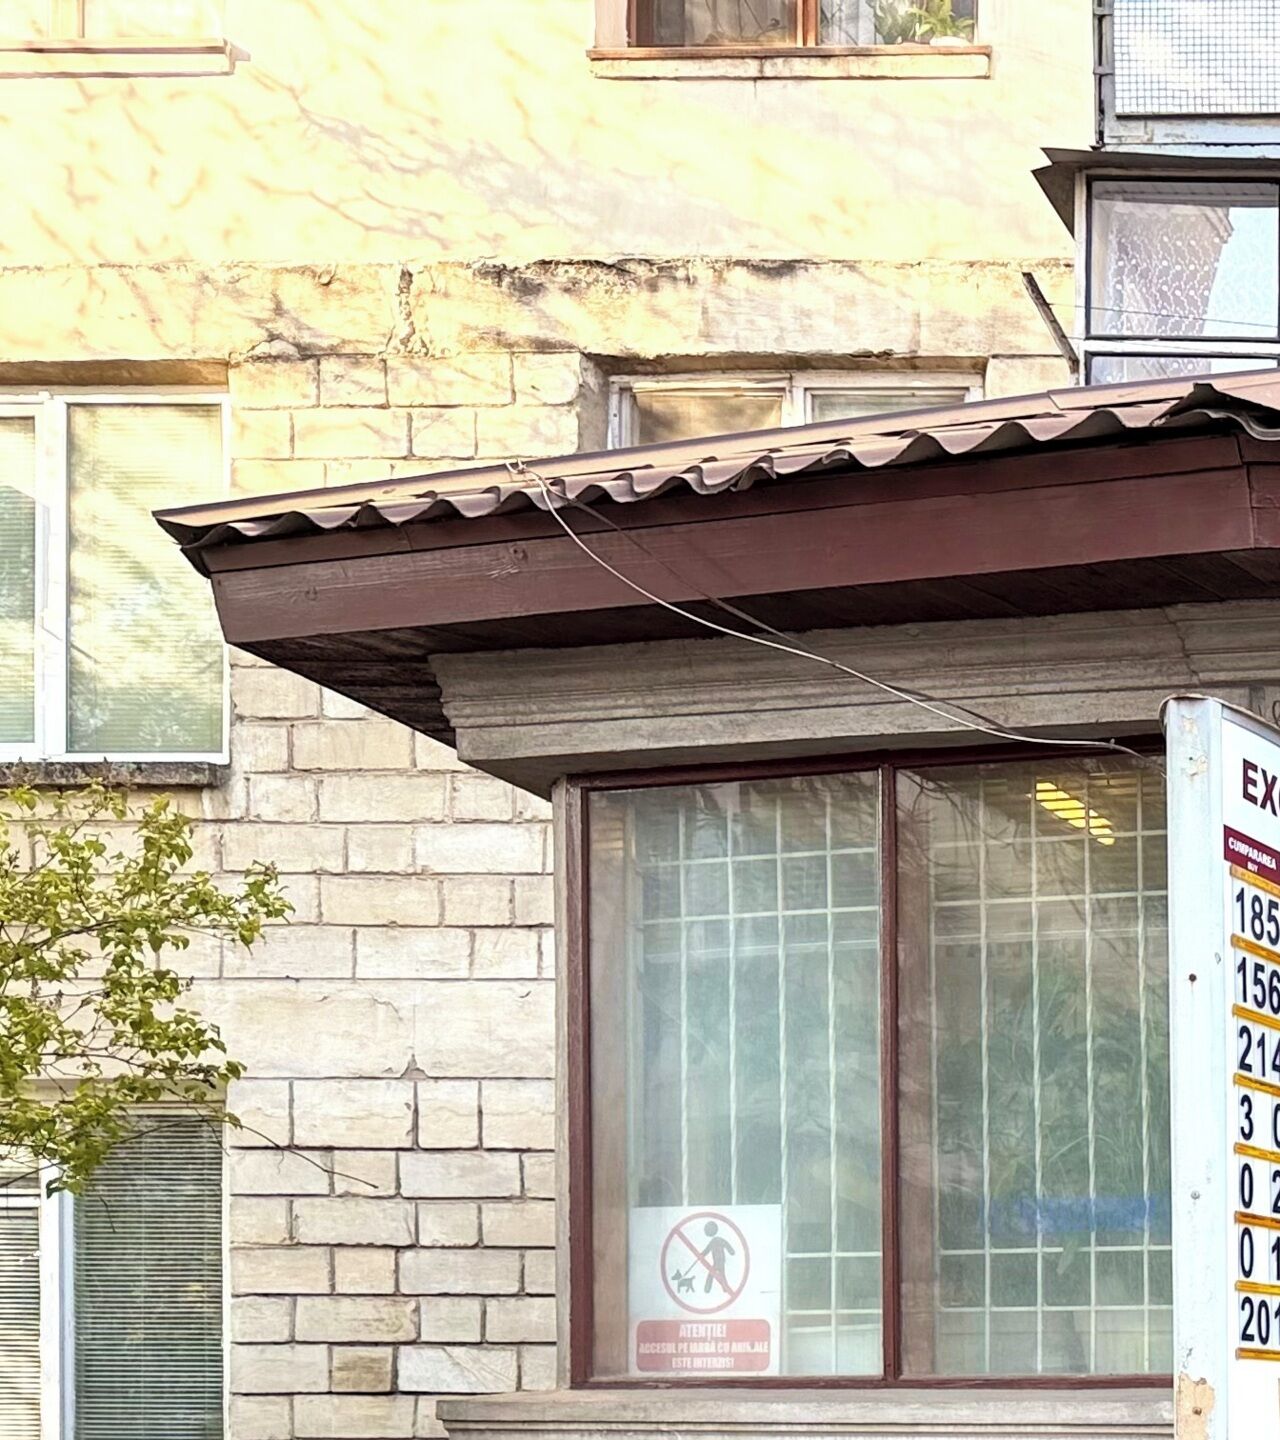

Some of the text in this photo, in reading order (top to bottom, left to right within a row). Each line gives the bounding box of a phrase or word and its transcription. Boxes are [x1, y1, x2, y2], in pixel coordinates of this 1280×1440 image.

[639, 1342, 676, 1354] ACCESUL
[678, 1343, 689, 1354] PE
[717, 1342, 730, 1354] CU
[672, 1357, 692, 1369] ESTE
